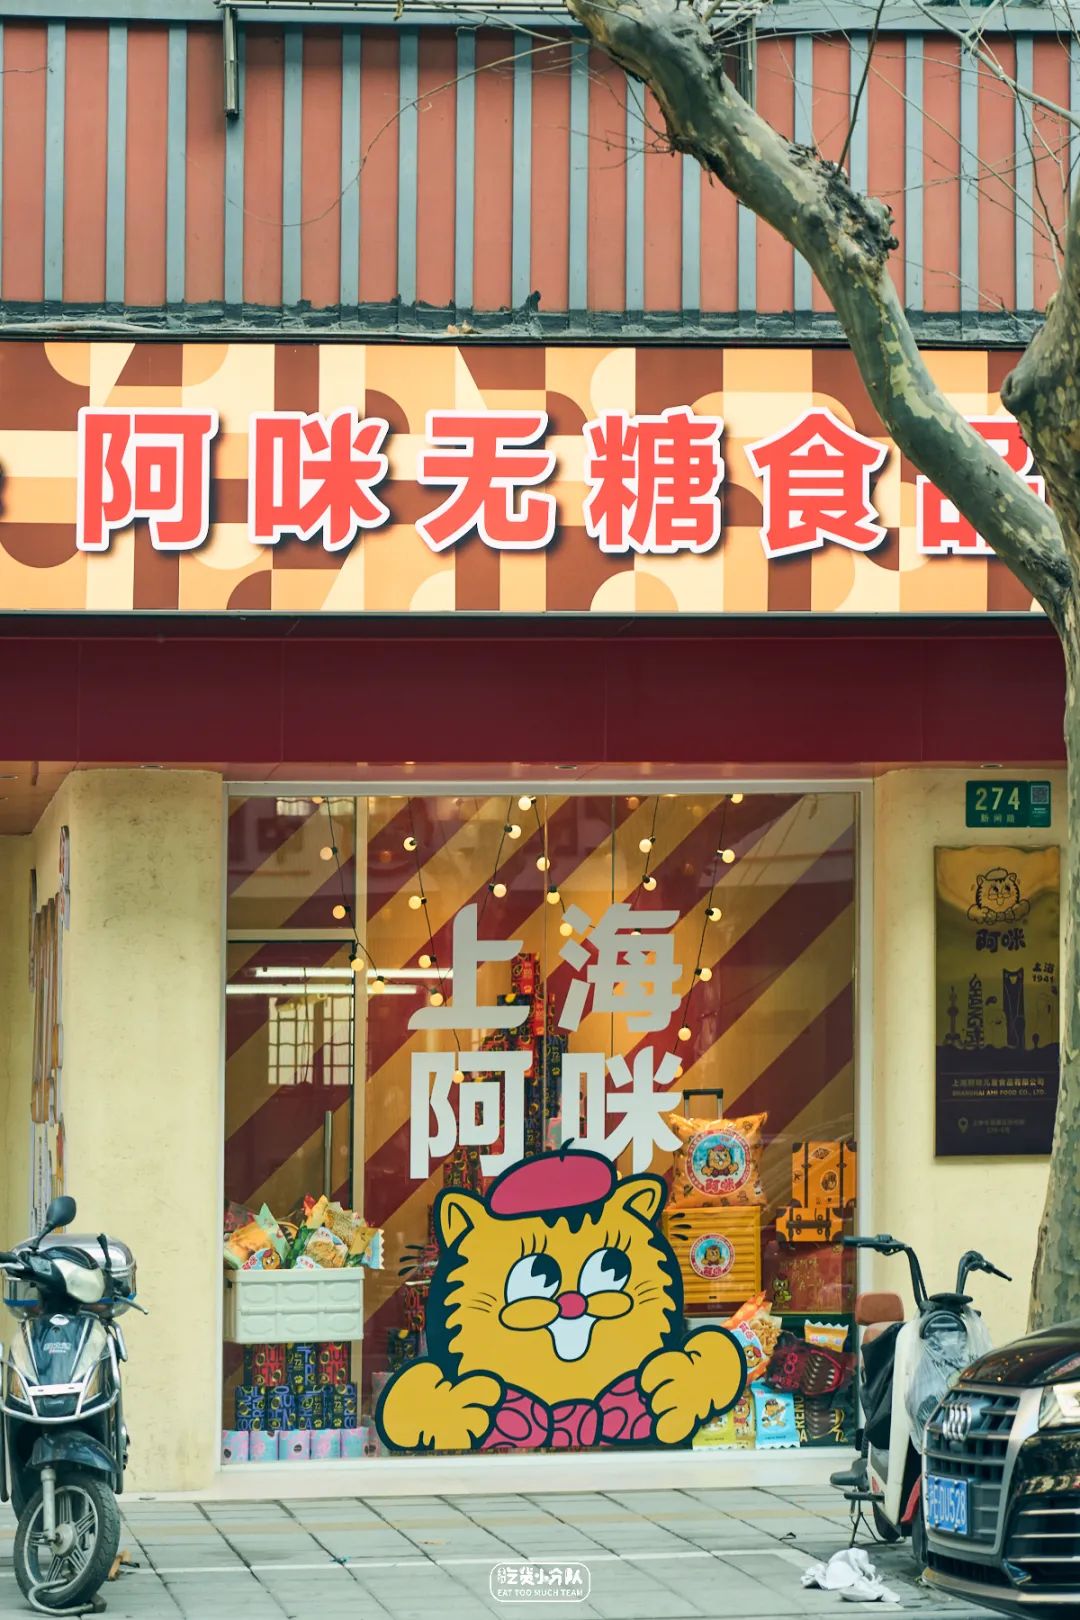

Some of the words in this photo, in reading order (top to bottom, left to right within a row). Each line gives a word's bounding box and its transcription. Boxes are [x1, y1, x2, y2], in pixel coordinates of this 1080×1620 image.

[975, 786, 1021, 811] 274
[975, 927, 1026, 953] 阿咪
[408, 902, 684, 1033] 上海
[1000, 1088, 1017, 1096] FOOD
[409, 1045, 684, 1180] 阿咪
[704, 1178, 736, 1193] 阿咪
